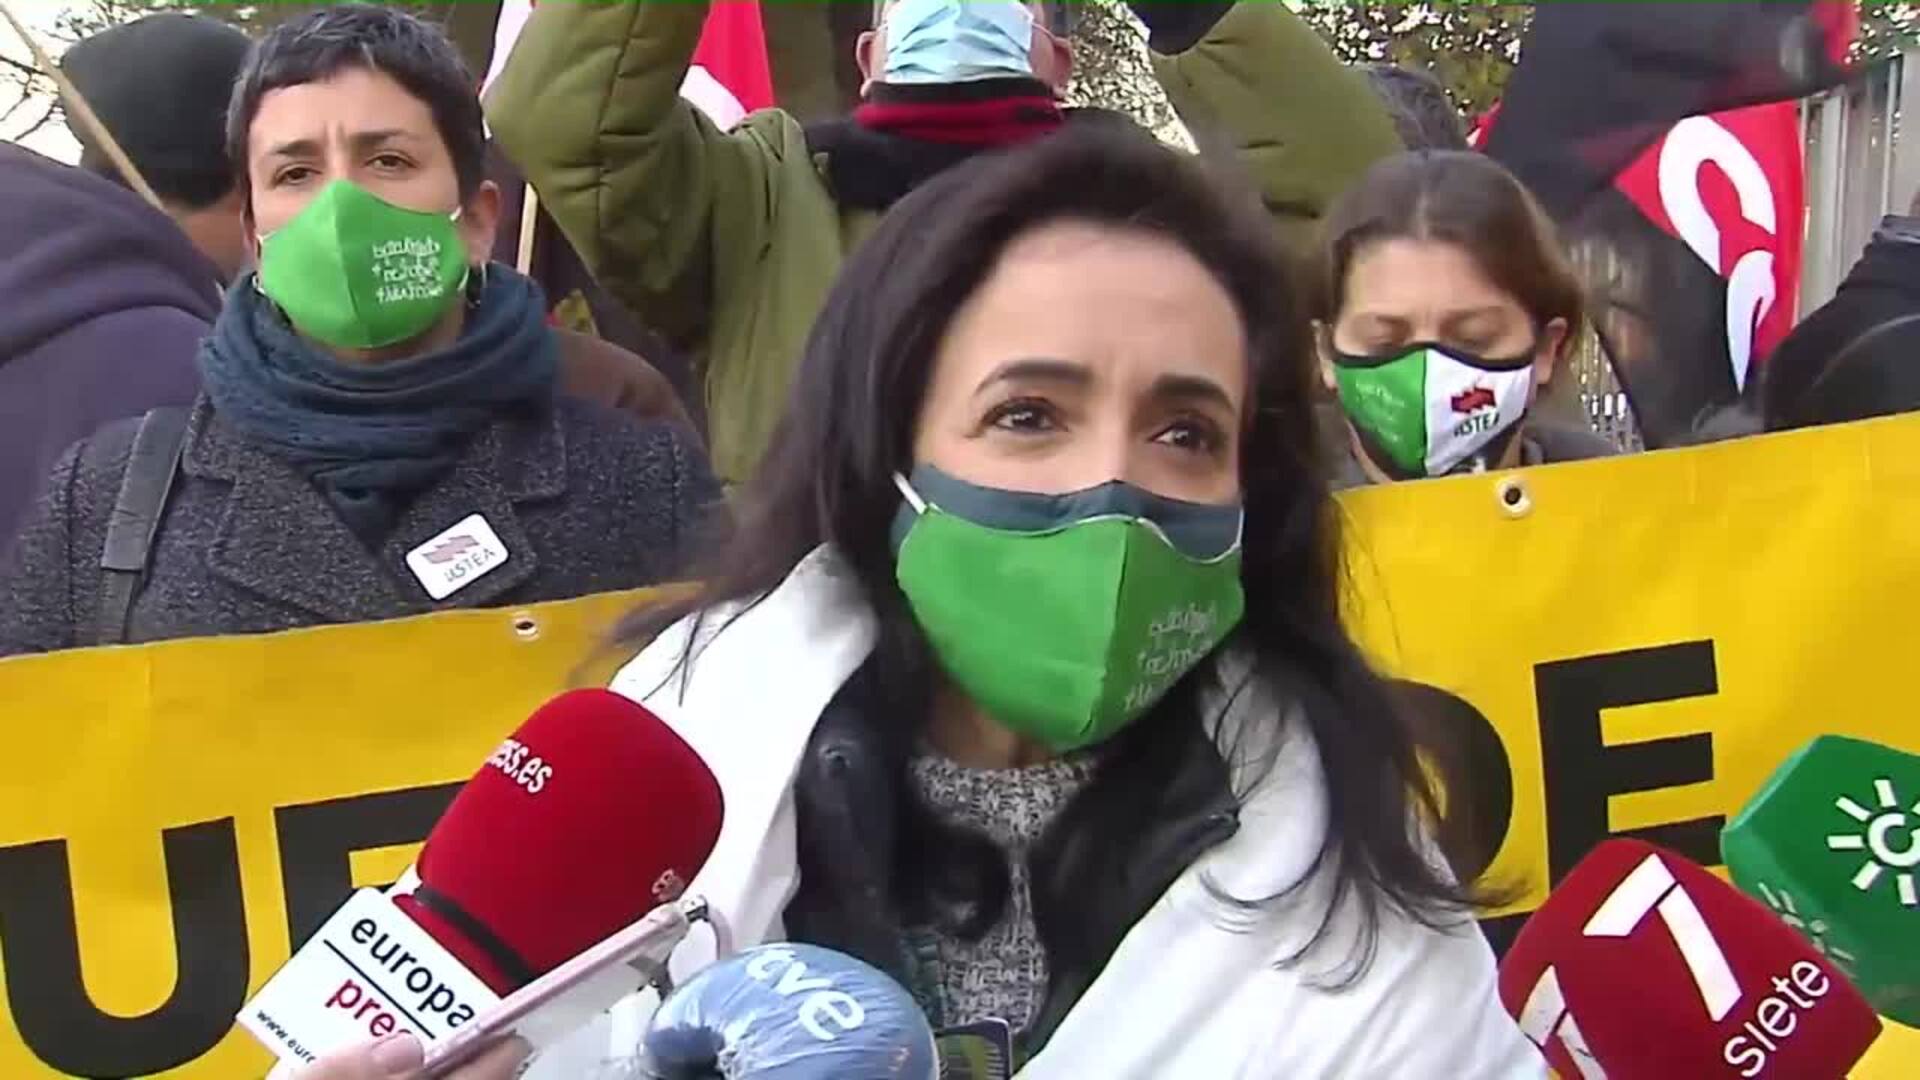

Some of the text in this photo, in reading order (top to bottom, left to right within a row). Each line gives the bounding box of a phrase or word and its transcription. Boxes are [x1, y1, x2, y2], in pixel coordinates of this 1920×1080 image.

[444, 548, 496, 582] USTEA
[350, 917, 476, 1028] europa
[1583, 853, 1743, 1022] 7
[325, 979, 413, 1037] pre
[1724, 960, 1830, 1078] siete
